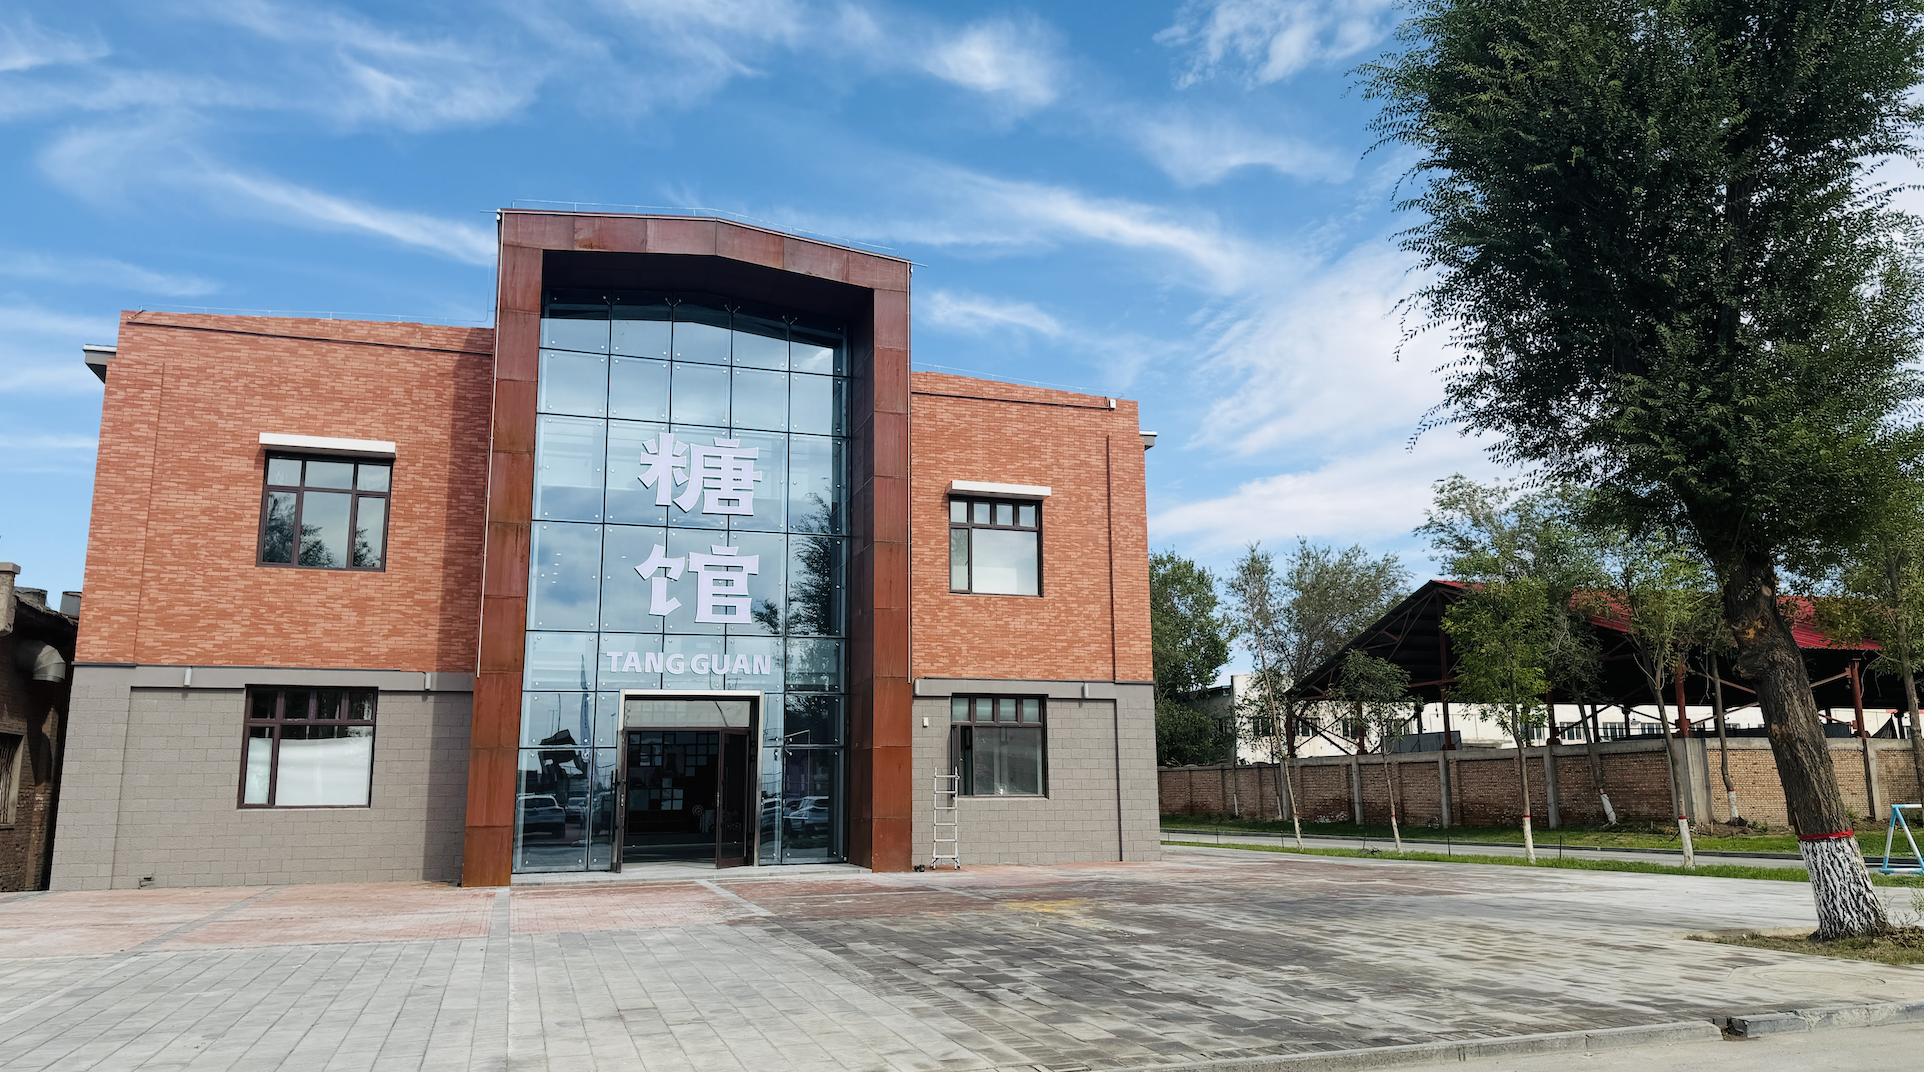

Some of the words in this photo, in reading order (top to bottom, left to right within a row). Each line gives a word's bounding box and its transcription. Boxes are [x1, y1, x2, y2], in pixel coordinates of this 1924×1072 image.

[635, 433, 762, 623] 糖馆
[607, 651, 685, 675] TANG
[691, 653, 771, 676] GUAN
